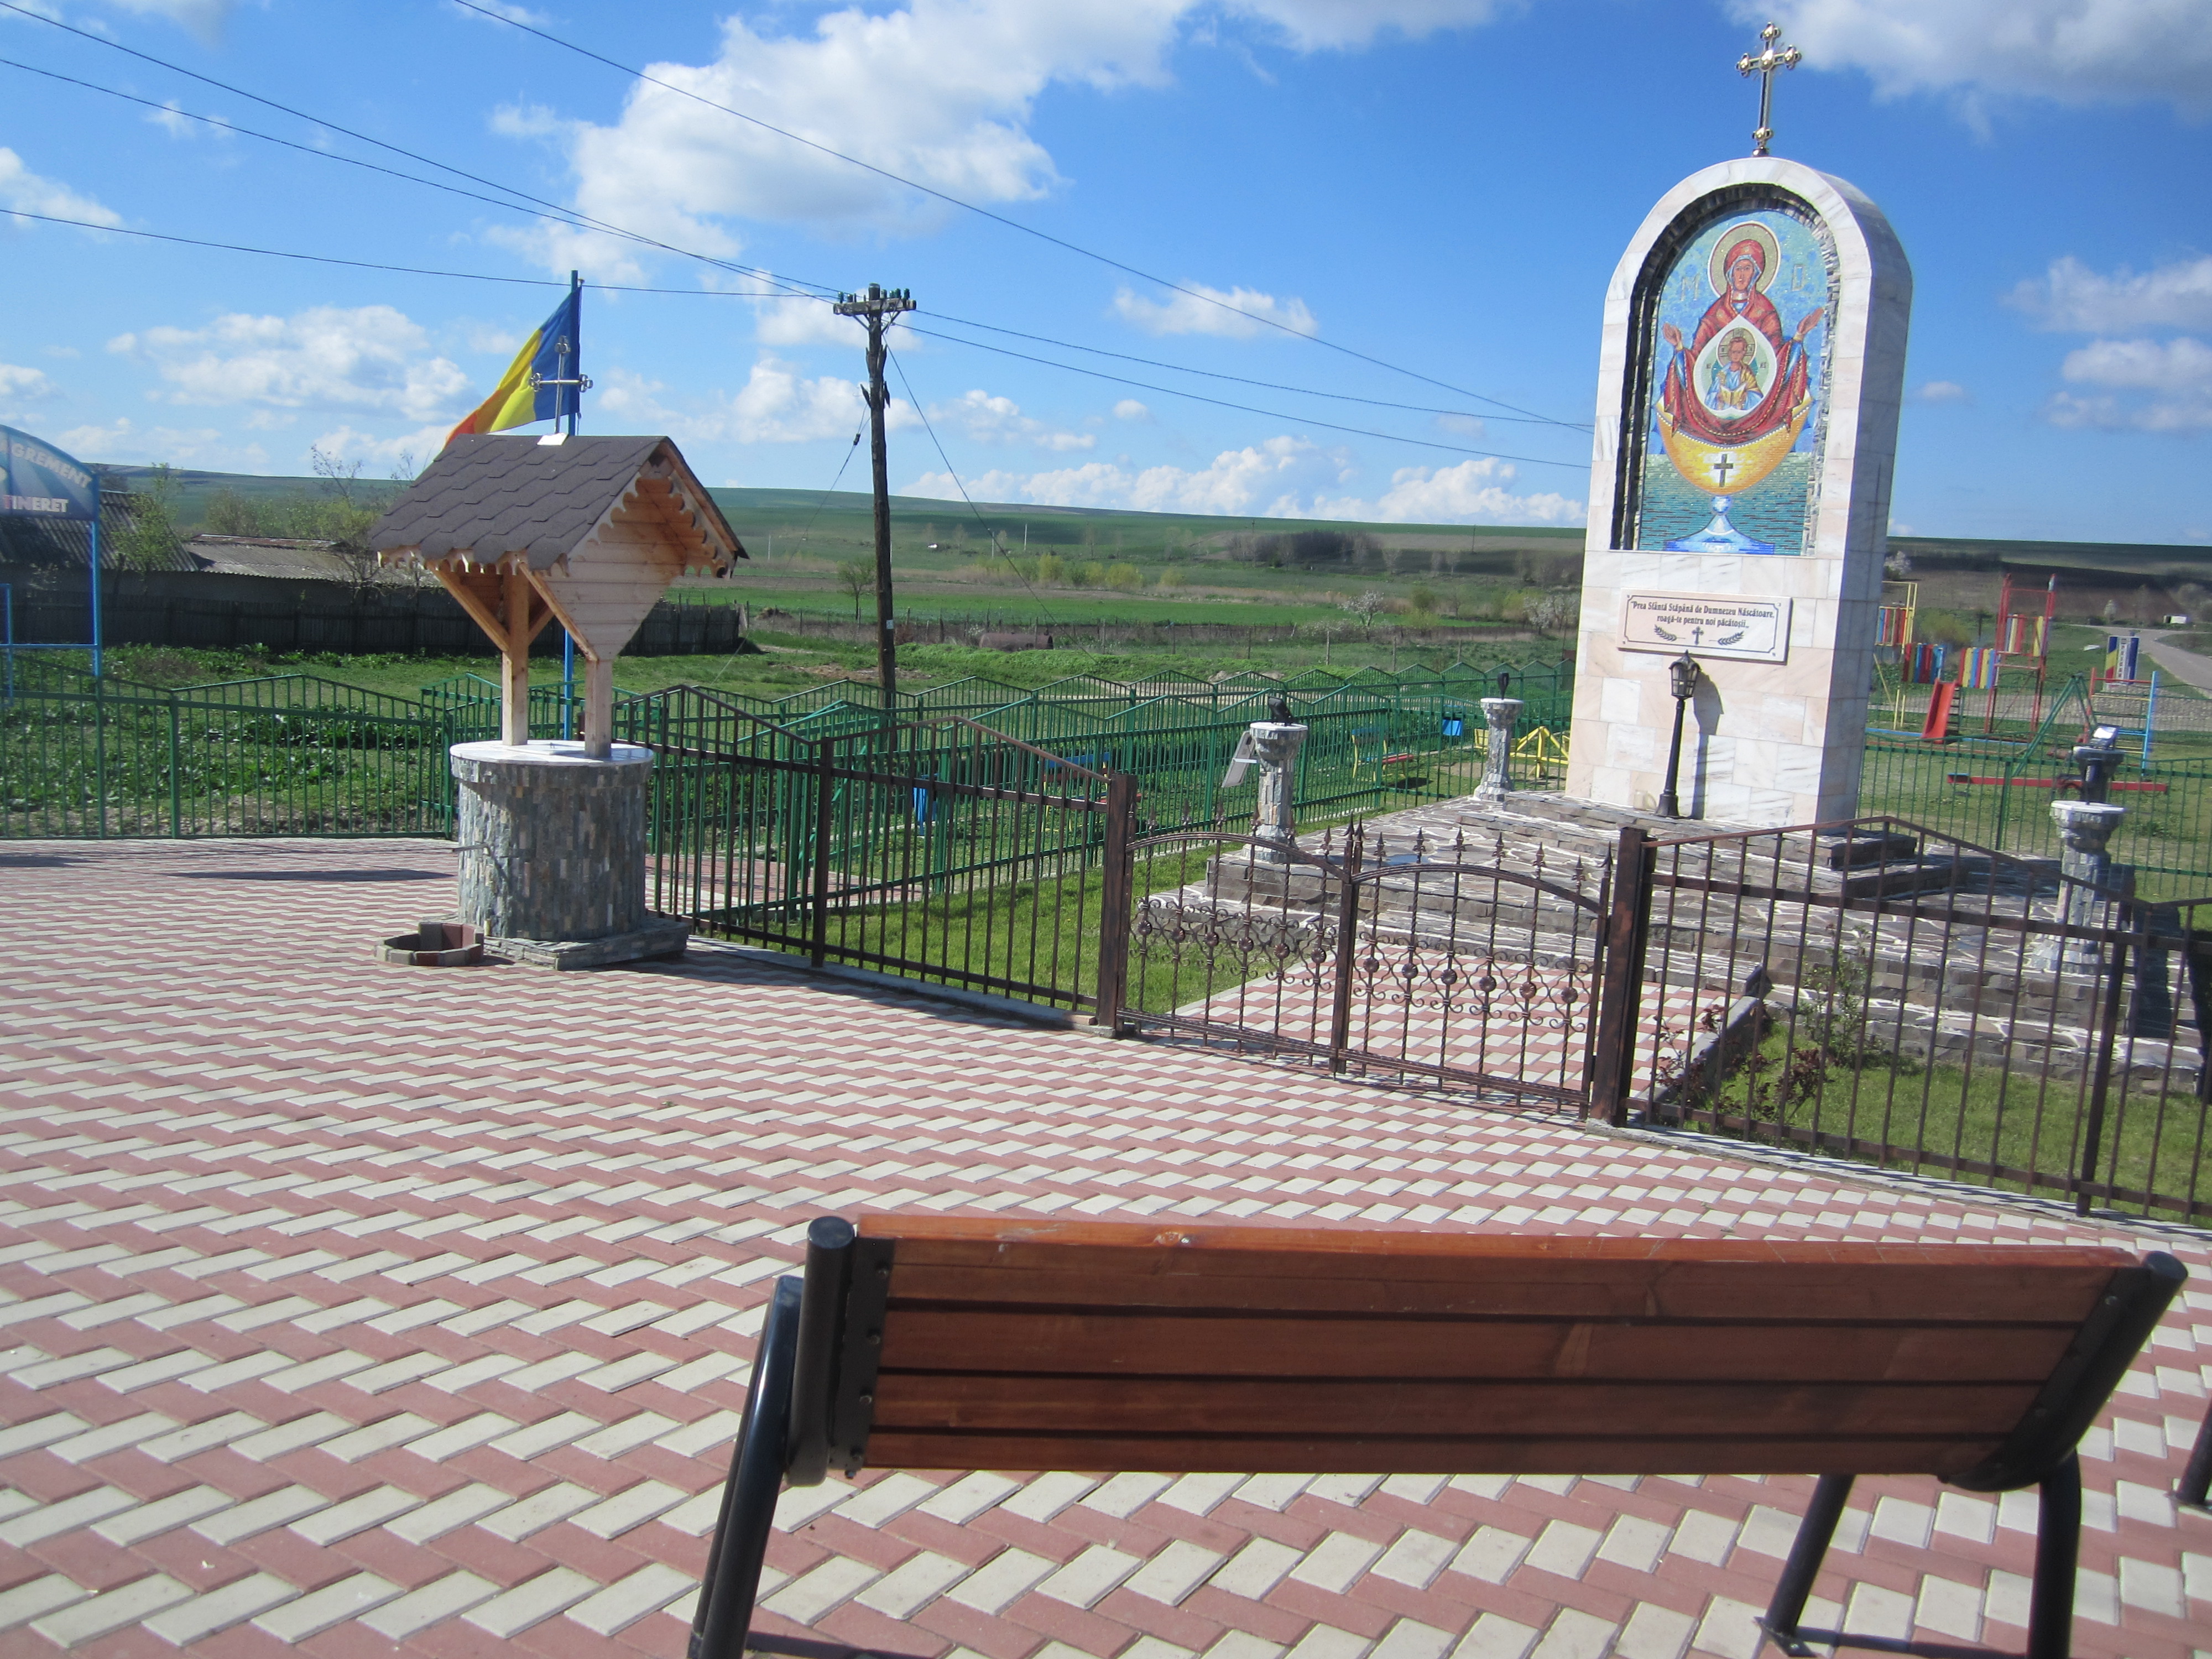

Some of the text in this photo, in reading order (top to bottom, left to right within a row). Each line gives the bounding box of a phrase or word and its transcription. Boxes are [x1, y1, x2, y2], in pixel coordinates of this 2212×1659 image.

[3, 494, 69, 513] TINERET
[1703, 606, 1736, 615] Dumnezeu
[1683, 617, 1704, 625] pentru
[1705, 617, 1716, 625] noi
